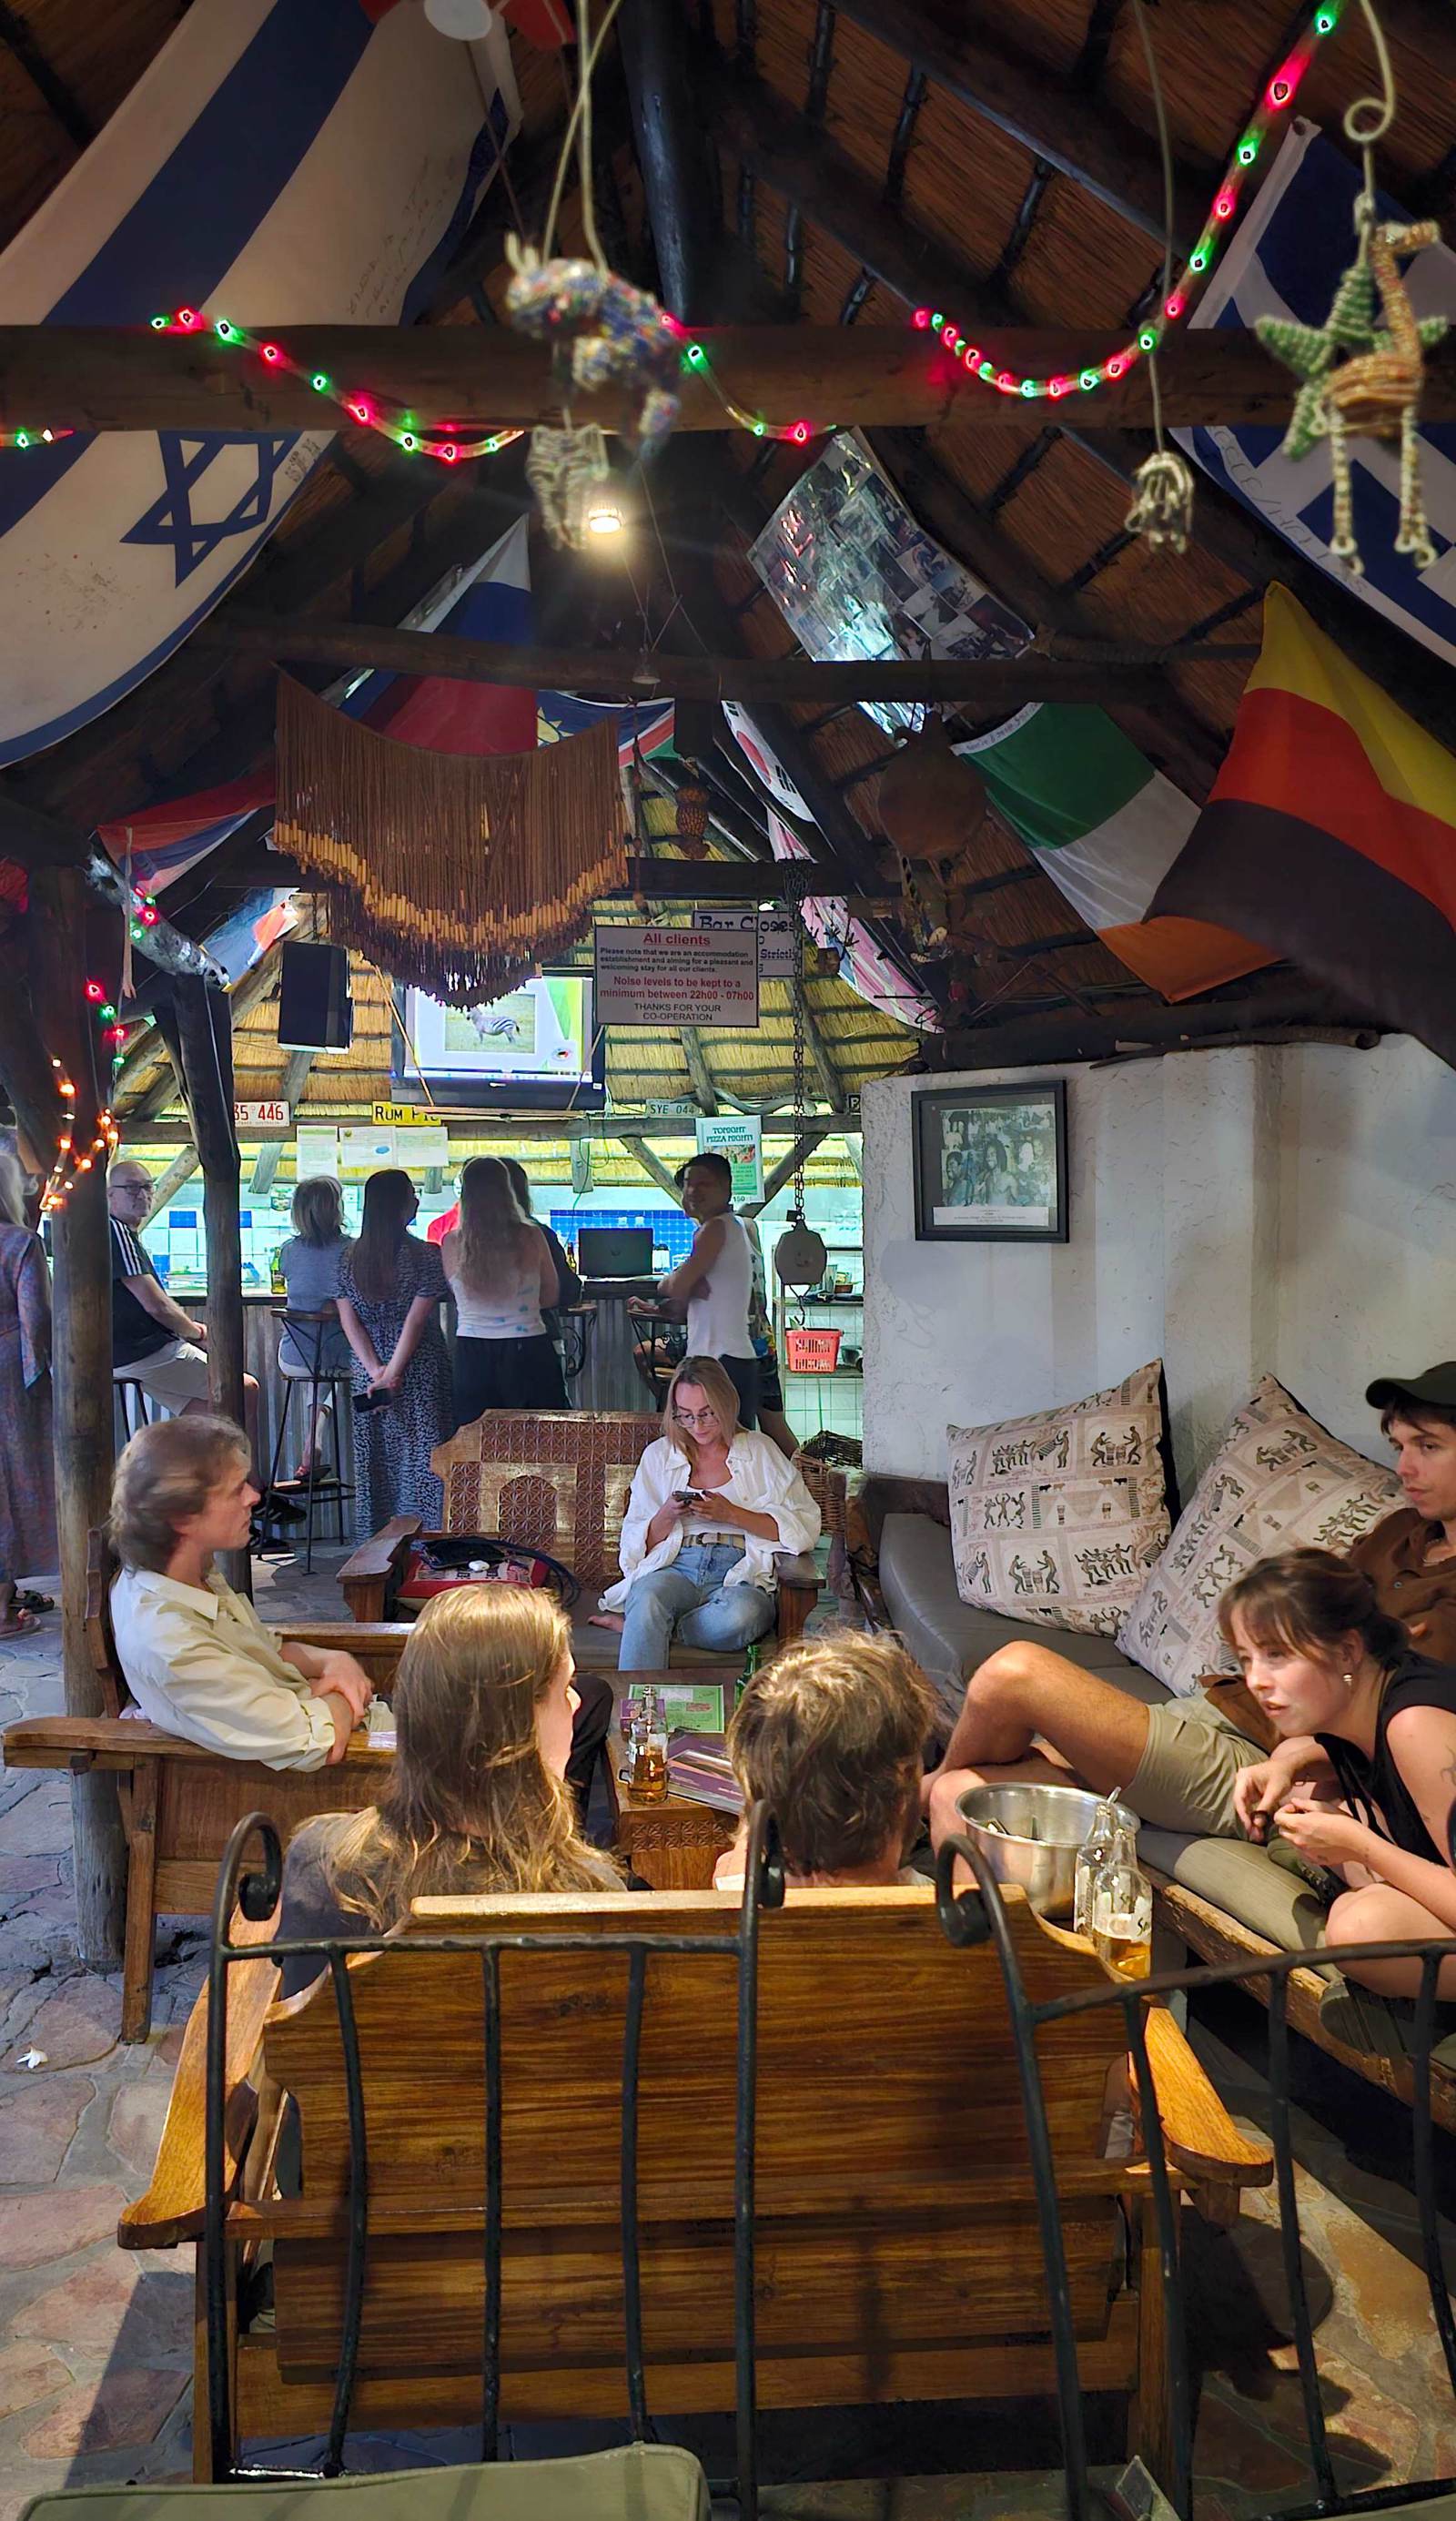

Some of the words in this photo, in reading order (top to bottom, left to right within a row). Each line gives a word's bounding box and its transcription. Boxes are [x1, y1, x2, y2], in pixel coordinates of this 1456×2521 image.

[699, 916, 733, 929] Bar
[740, 916, 794, 932] Coses
[643, 932, 662, 944] All
[665, 933, 711, 946] clients
[601, 947, 624, 955] Please
[666, 957, 691, 966] aiming
[710, 957, 739, 966] pleasant
[641, 965, 655, 973] stay
[613, 976, 642, 986] Noise
[643, 977, 672, 987] levels
[674, 978, 684, 987] to
[686, 978, 698, 987] be
[701, 978, 722, 989] kept
[723, 979, 733, 988] to
[600, 987, 645, 998] minimum
[647, 988, 687, 998] between
[690, 989, 718, 999] 22h00
[726, 990, 754, 1001] 07h00
[633, 1003, 672, 1011] THANKS
[673, 1004, 693, 1012] FOR
[694, 1004, 722, 1012] YOUR
[642, 1012, 713, 1021] CO-OPERATION
[258, 1103, 284, 1120] 446
[650, 1104, 669, 1115] SYE
